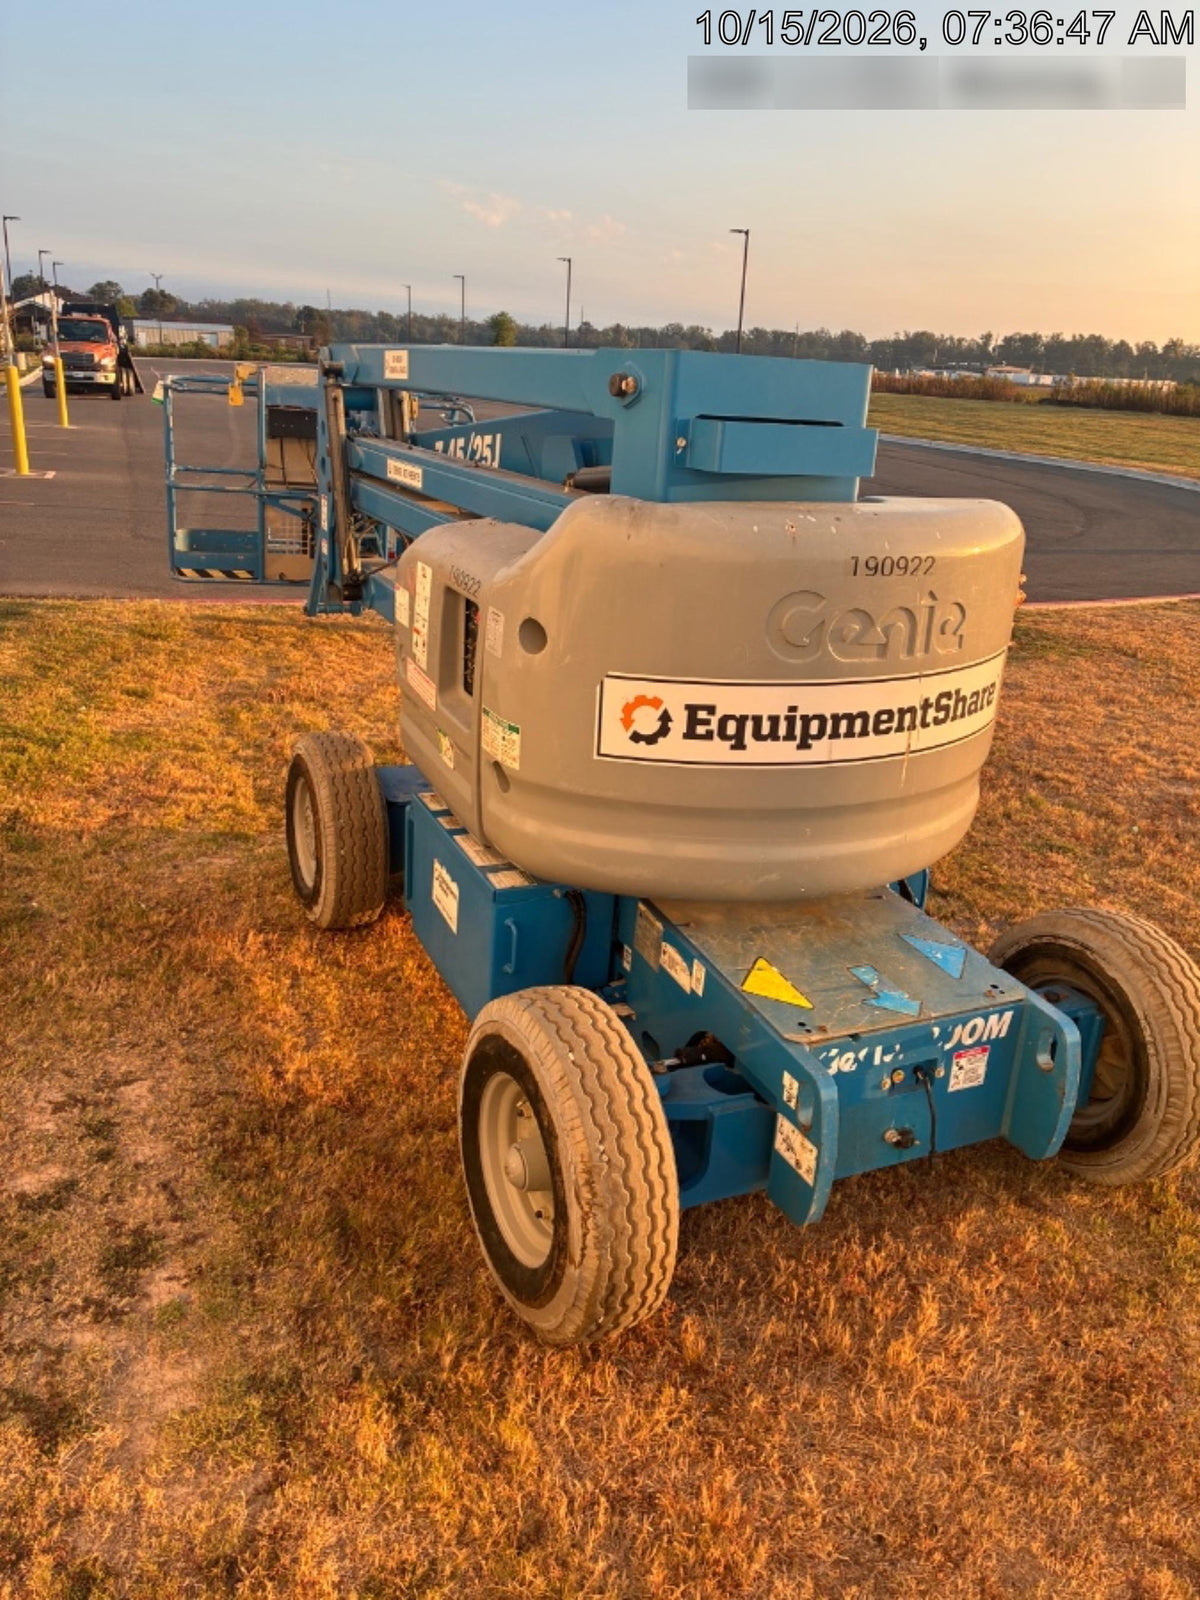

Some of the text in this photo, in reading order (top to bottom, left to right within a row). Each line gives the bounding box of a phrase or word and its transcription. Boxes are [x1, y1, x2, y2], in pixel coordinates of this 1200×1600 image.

[850, 556, 936, 577] 190922
[767, 590, 967, 663] Genie
[682, 681, 996, 750] EquipmentShare
